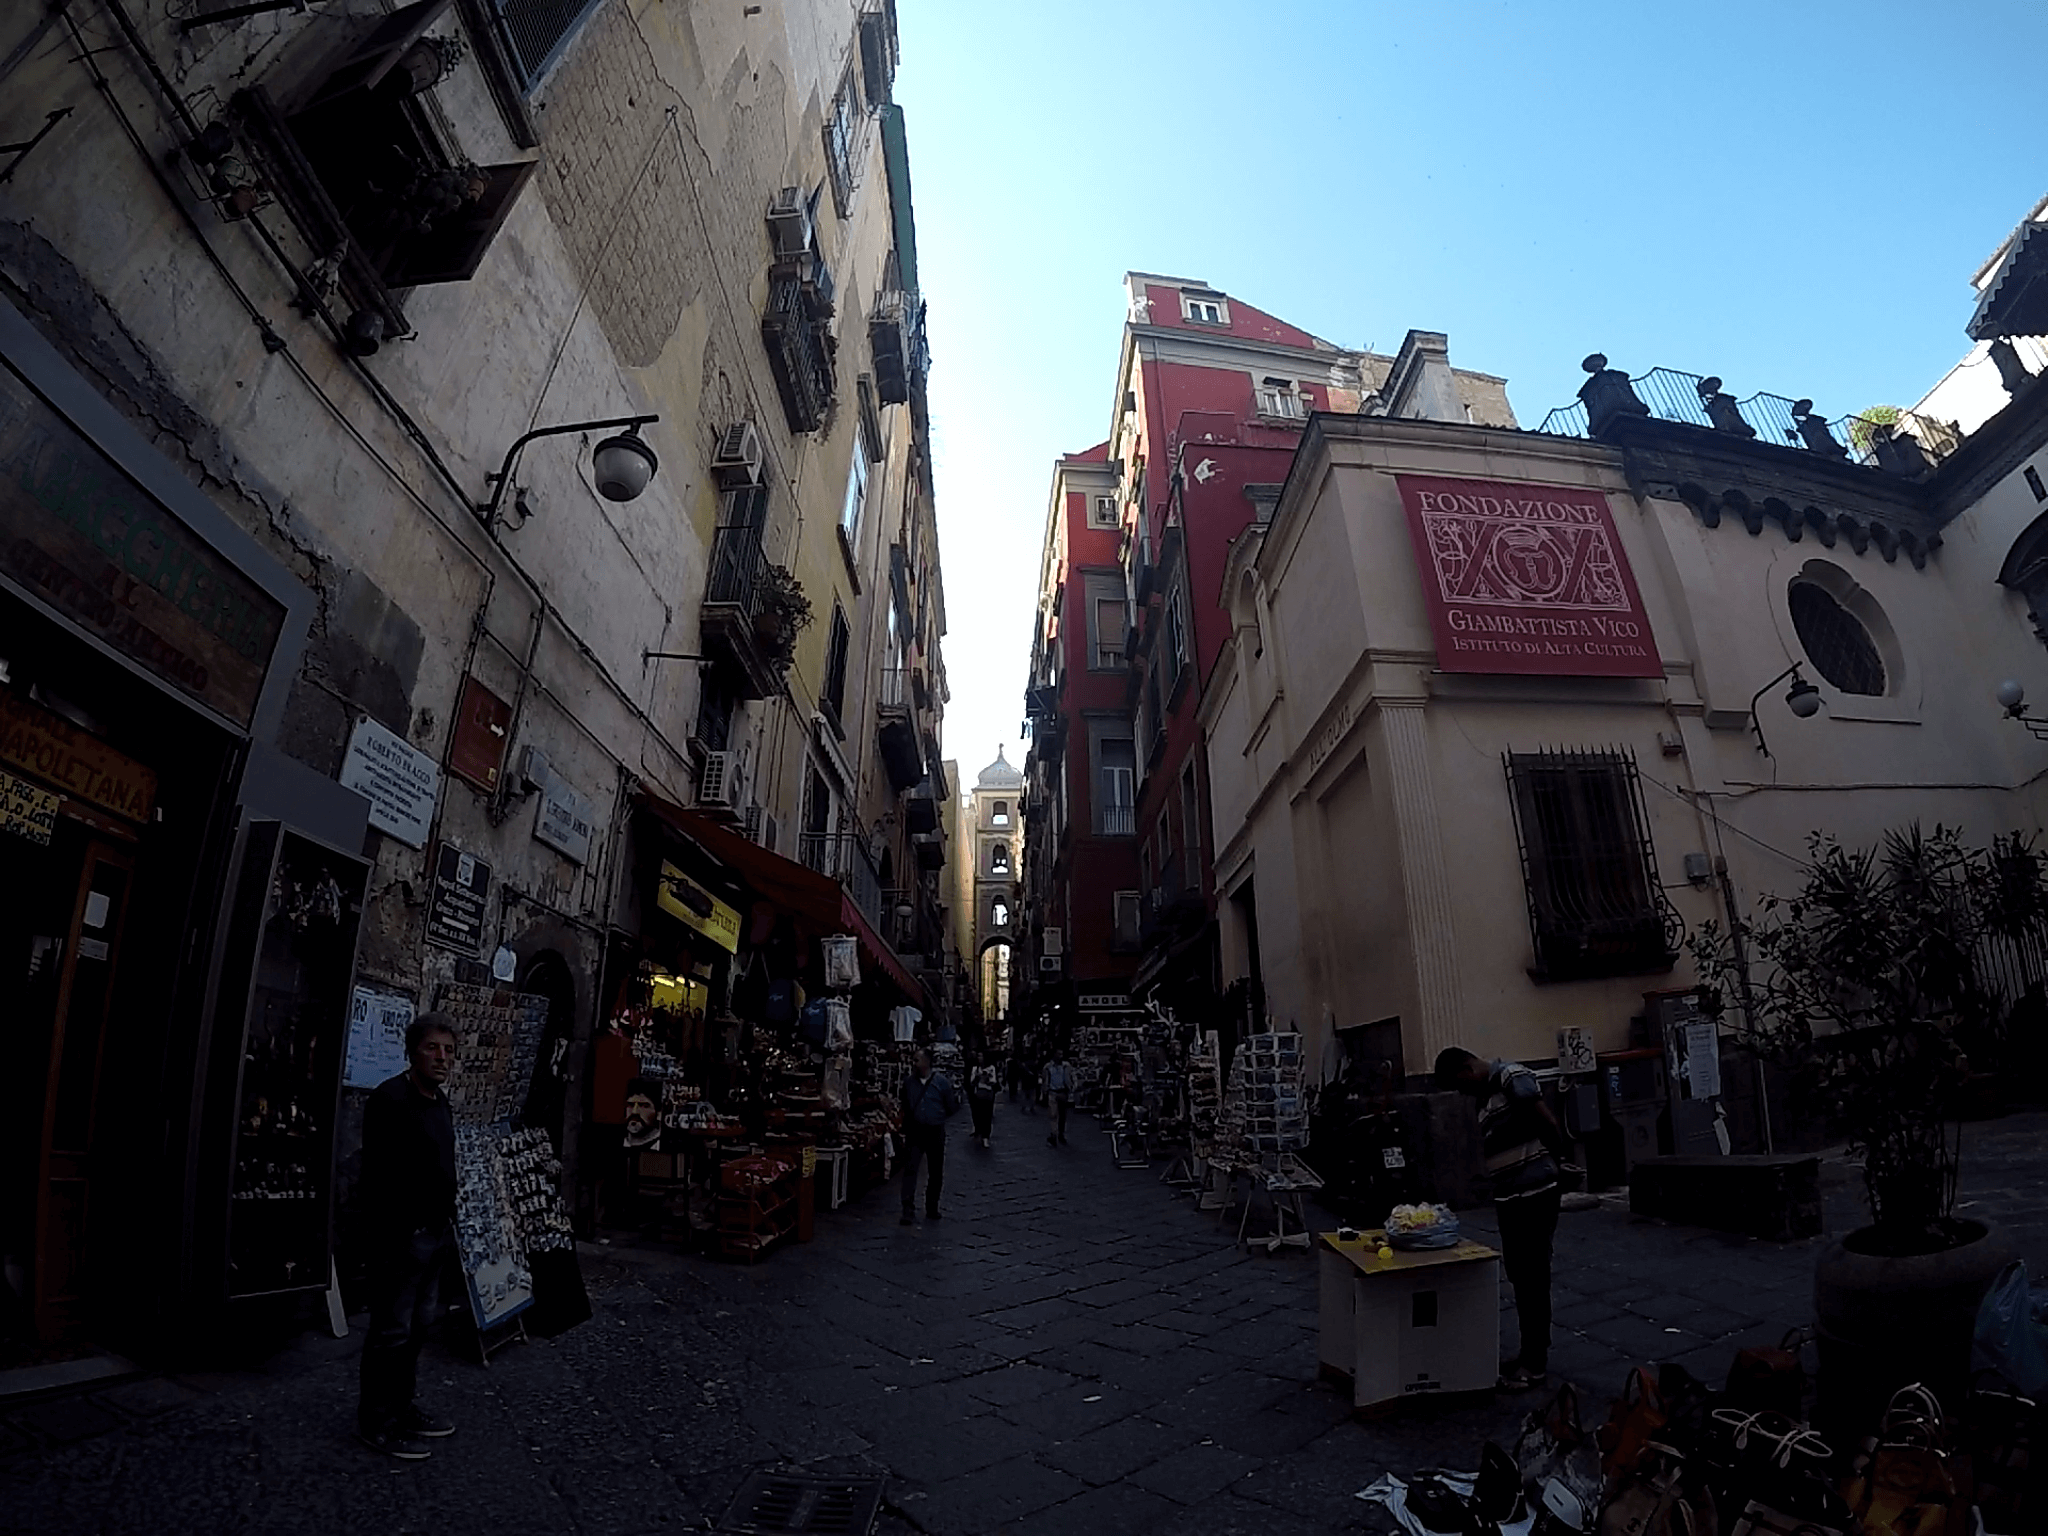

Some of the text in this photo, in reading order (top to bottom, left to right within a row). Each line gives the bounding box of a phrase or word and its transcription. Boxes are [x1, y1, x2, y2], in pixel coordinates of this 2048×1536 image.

[1416, 491, 1602, 524] FONDAZIONE
[1447, 609, 1639, 639] GIAMBATTISTA VICO
[1452, 637, 1648, 657] ISTITUTO DI ALTA CULTURA
[0, 726, 145, 817] APOLETANA
